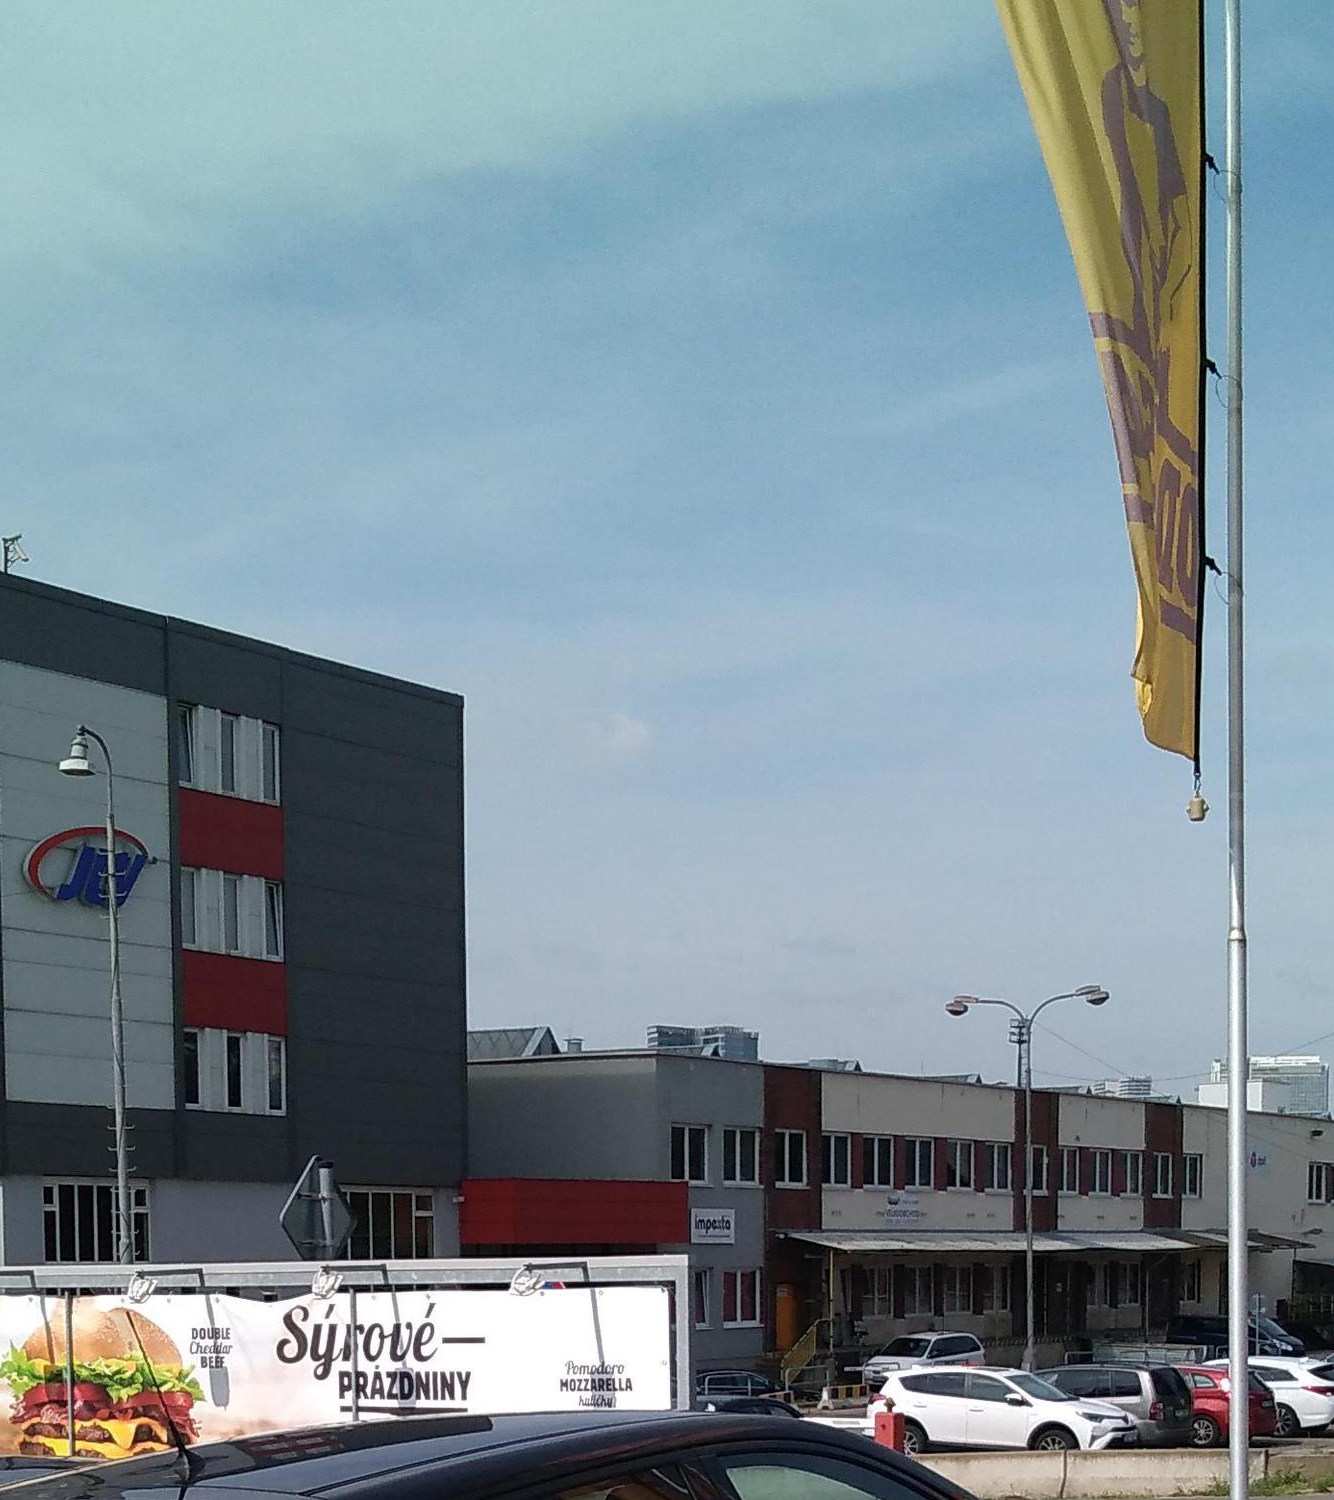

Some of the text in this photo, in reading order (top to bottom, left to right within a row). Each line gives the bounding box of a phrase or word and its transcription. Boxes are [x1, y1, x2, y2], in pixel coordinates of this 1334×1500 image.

[191, 1327, 231, 1340] DOUBLE
[189, 1340, 233, 1355] Cheddar
[276, 1302, 438, 1381] Sýrové
[200, 1355, 225, 1369] BEEF
[565, 1360, 625, 1375] Pomodoro
[339, 1365, 472, 1401] PRÁZDNINY
[560, 1378, 633, 1392] MOZZARELLA
